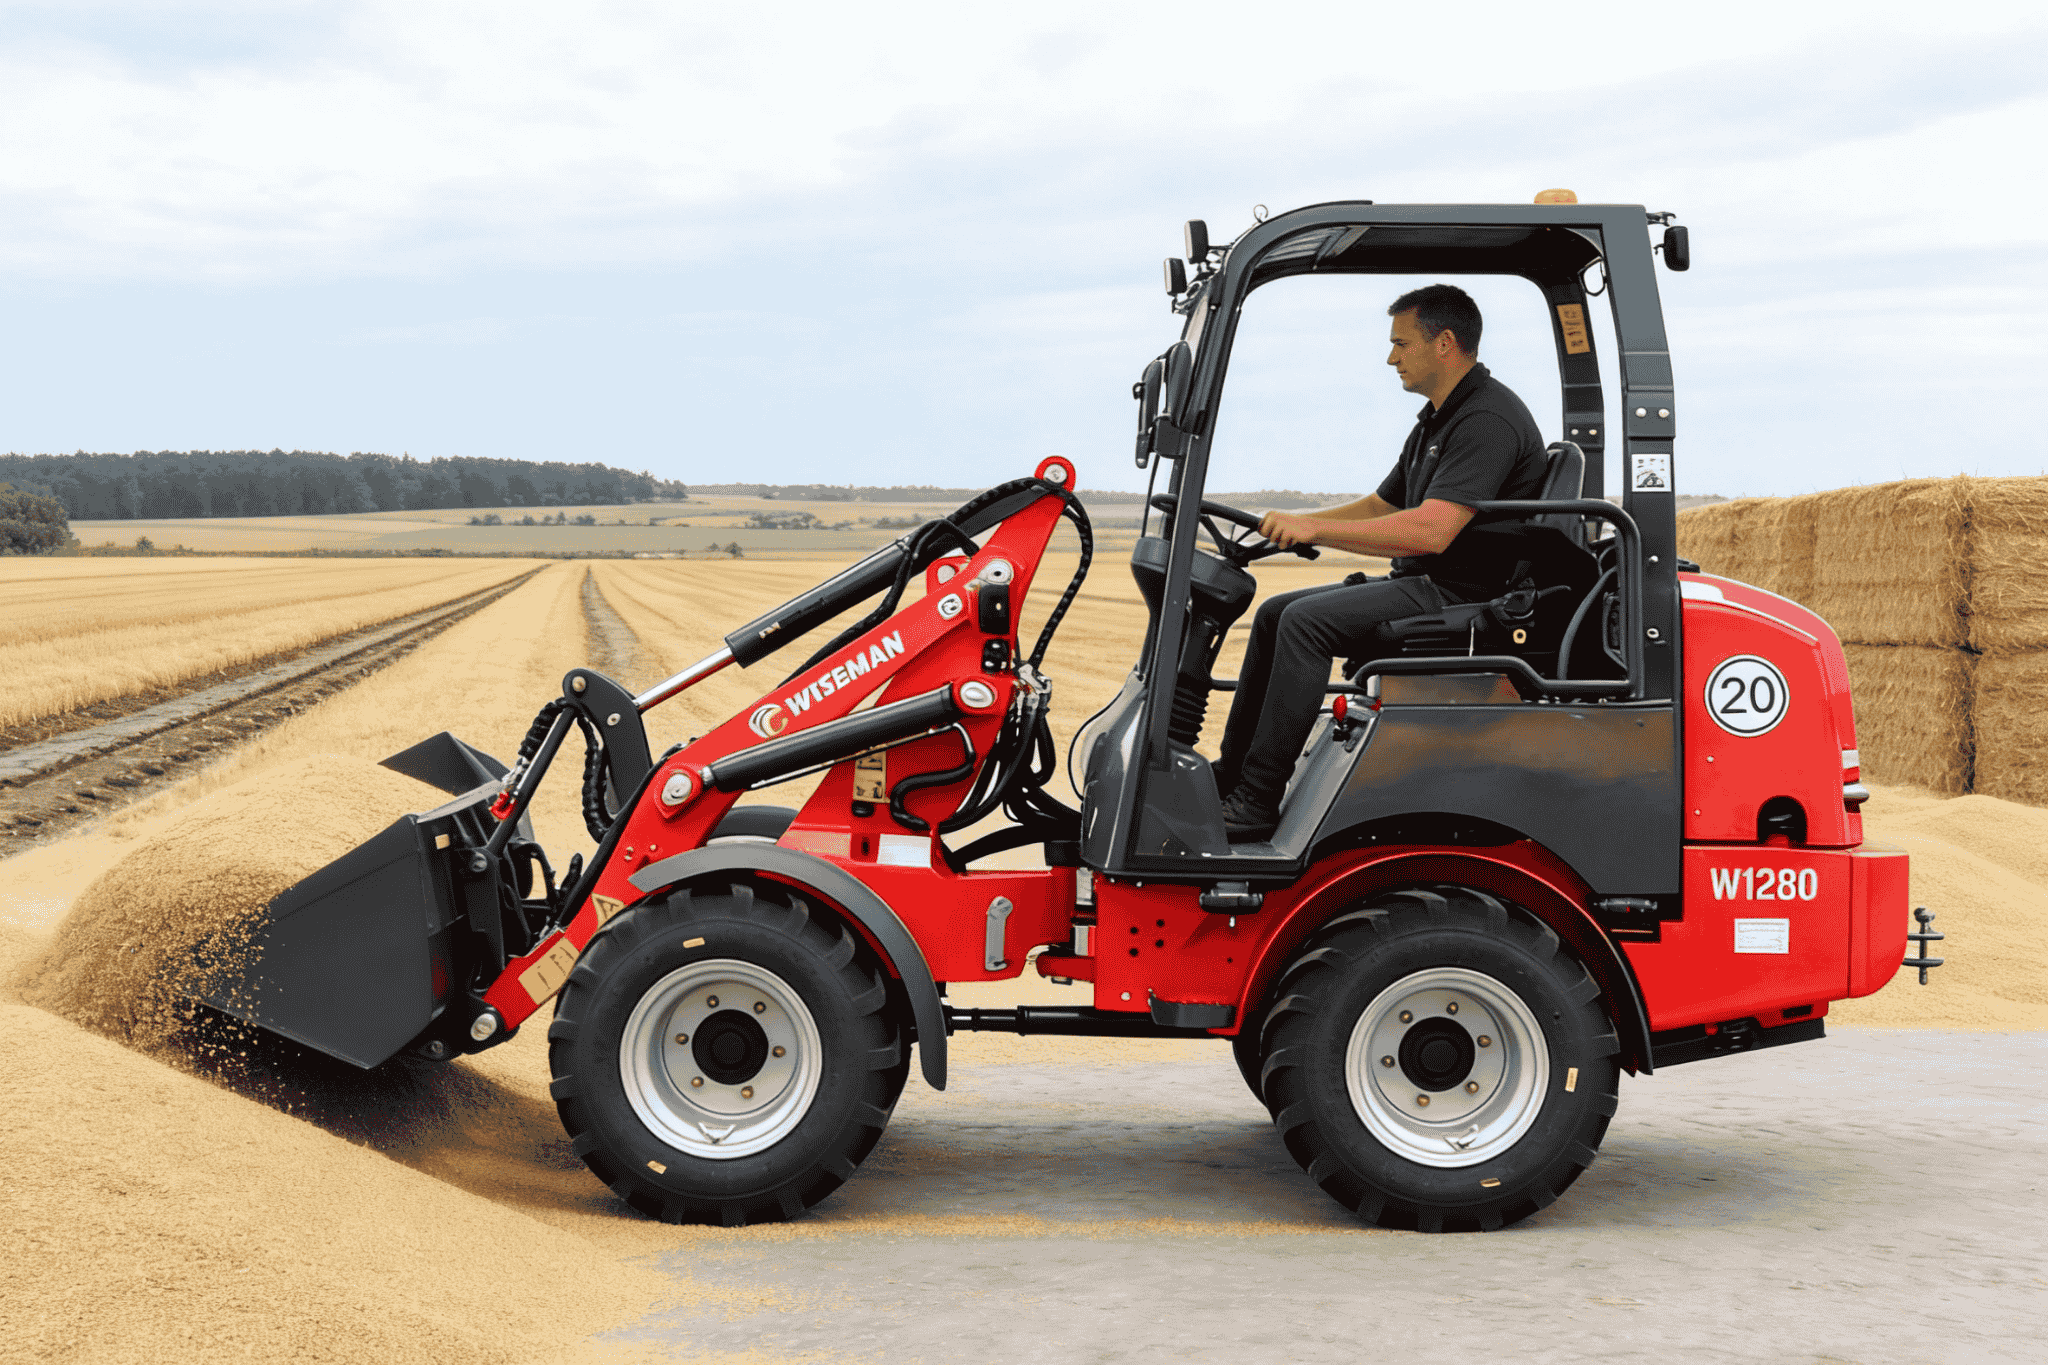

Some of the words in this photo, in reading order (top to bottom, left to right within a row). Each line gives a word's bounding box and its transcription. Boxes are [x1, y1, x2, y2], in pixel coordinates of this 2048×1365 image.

[784, 630, 905, 717] WISEMAN
[1720, 675, 1775, 714] 20
[1710, 867, 1818, 901] W1280
